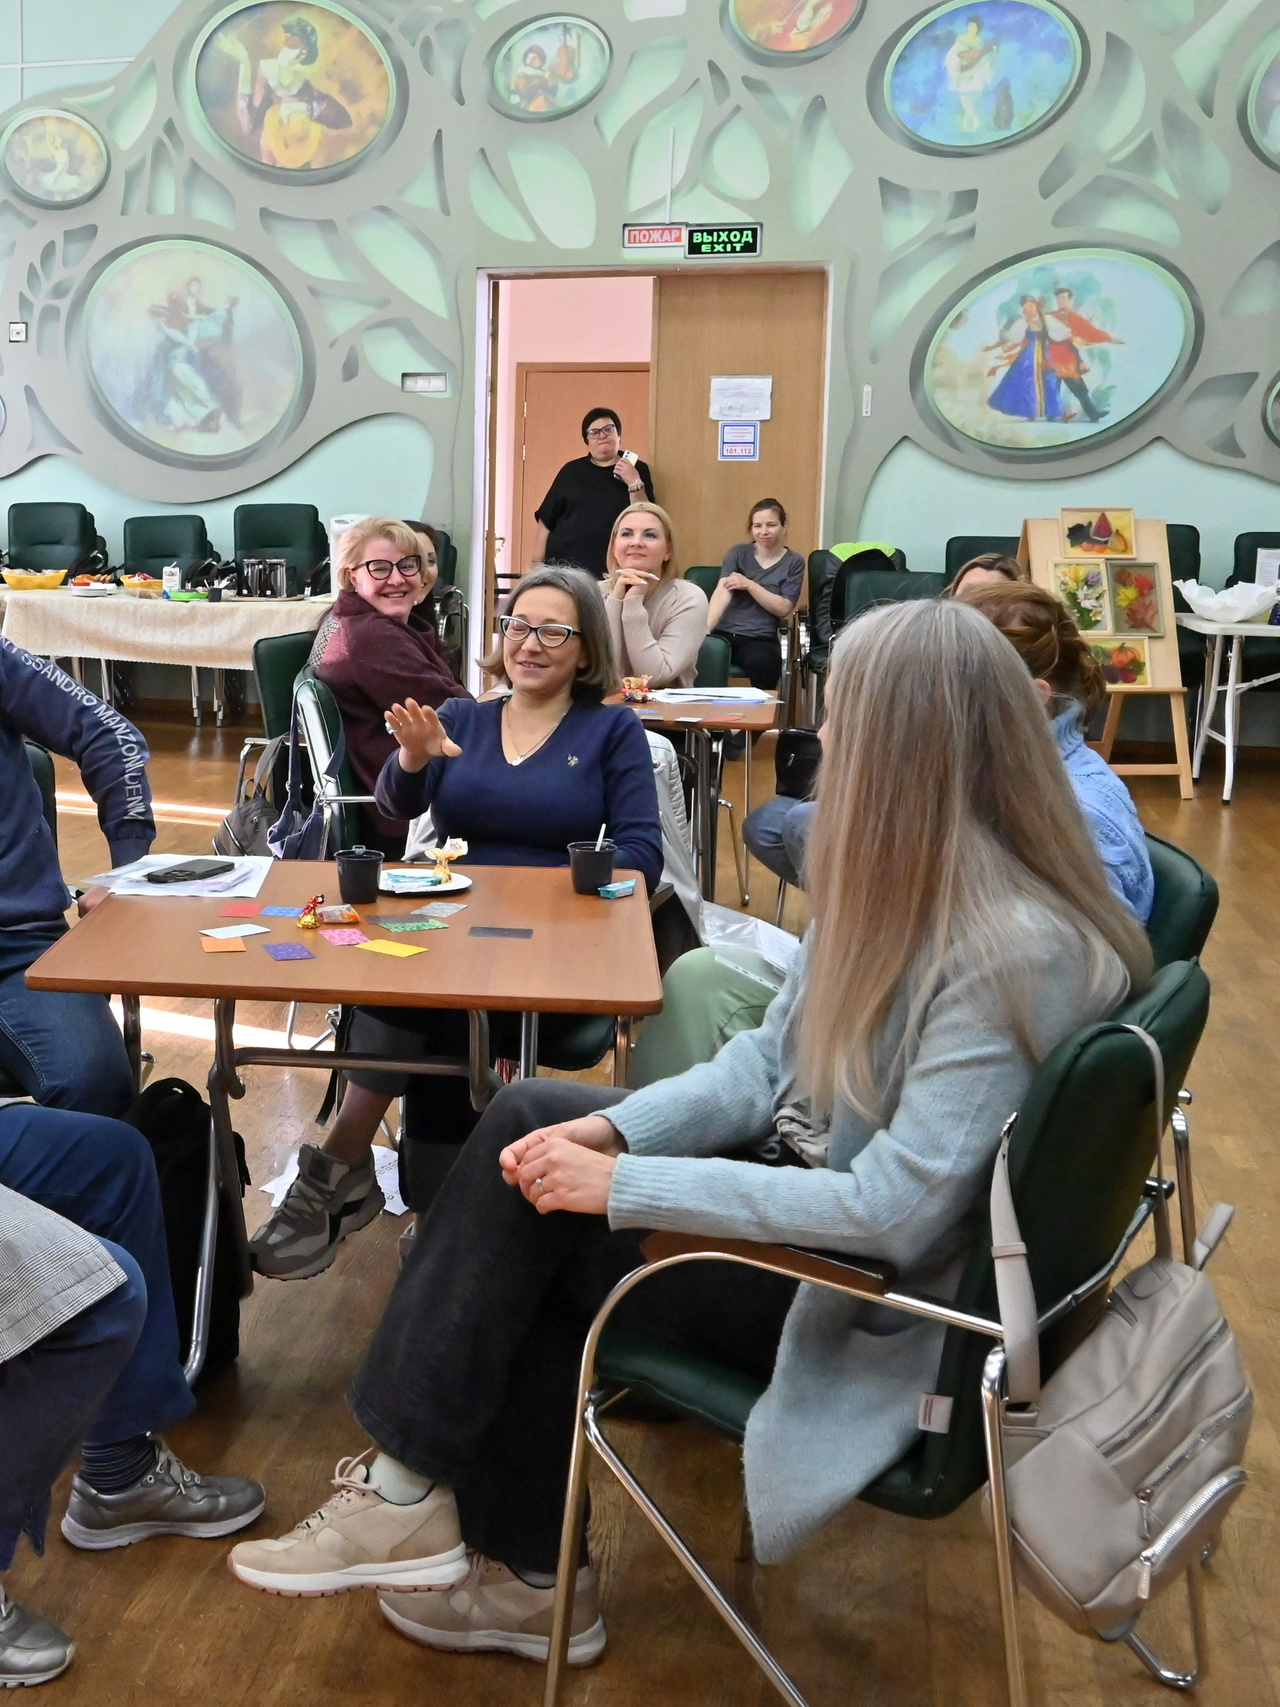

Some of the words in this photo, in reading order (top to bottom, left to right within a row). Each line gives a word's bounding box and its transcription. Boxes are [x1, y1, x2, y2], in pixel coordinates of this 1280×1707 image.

[630, 230, 680, 243] ПОЖАР
[693, 231, 753, 243] ВЫХОД
[701, 243, 744, 252] EXIT
[93, 704, 145, 773] MANZONI
